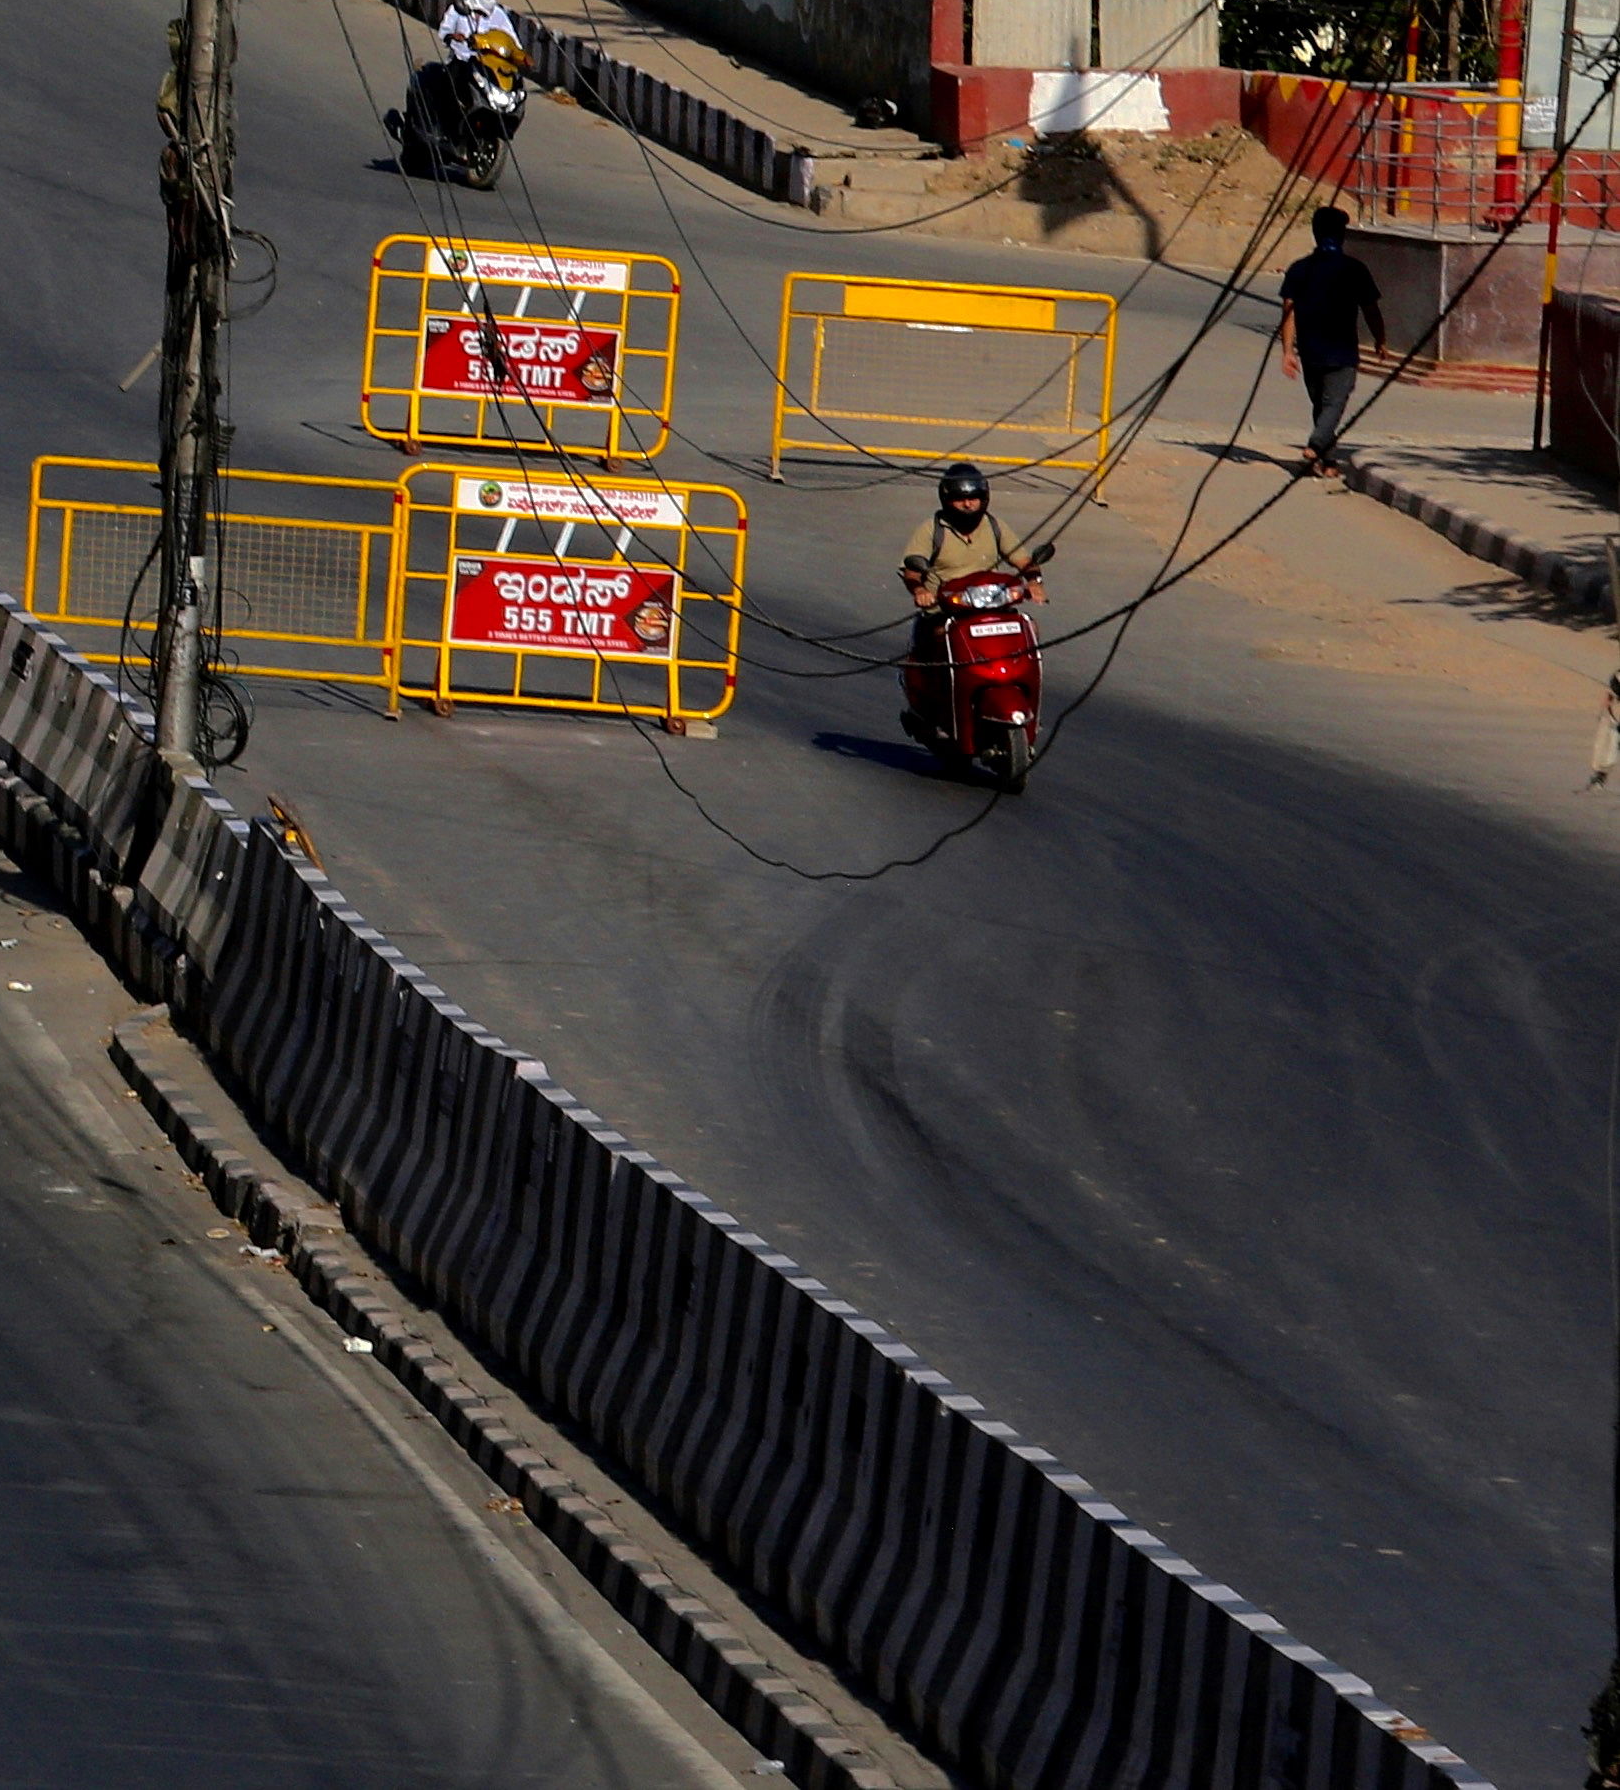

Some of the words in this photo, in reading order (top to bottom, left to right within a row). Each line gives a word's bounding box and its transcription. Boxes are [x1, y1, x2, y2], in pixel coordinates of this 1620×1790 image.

[518, 363, 567, 388] TMT
[493, 567, 632, 608] ಇಂಡಸ್
[503, 605, 553, 633] 555
[560, 609, 617, 638] TMT
